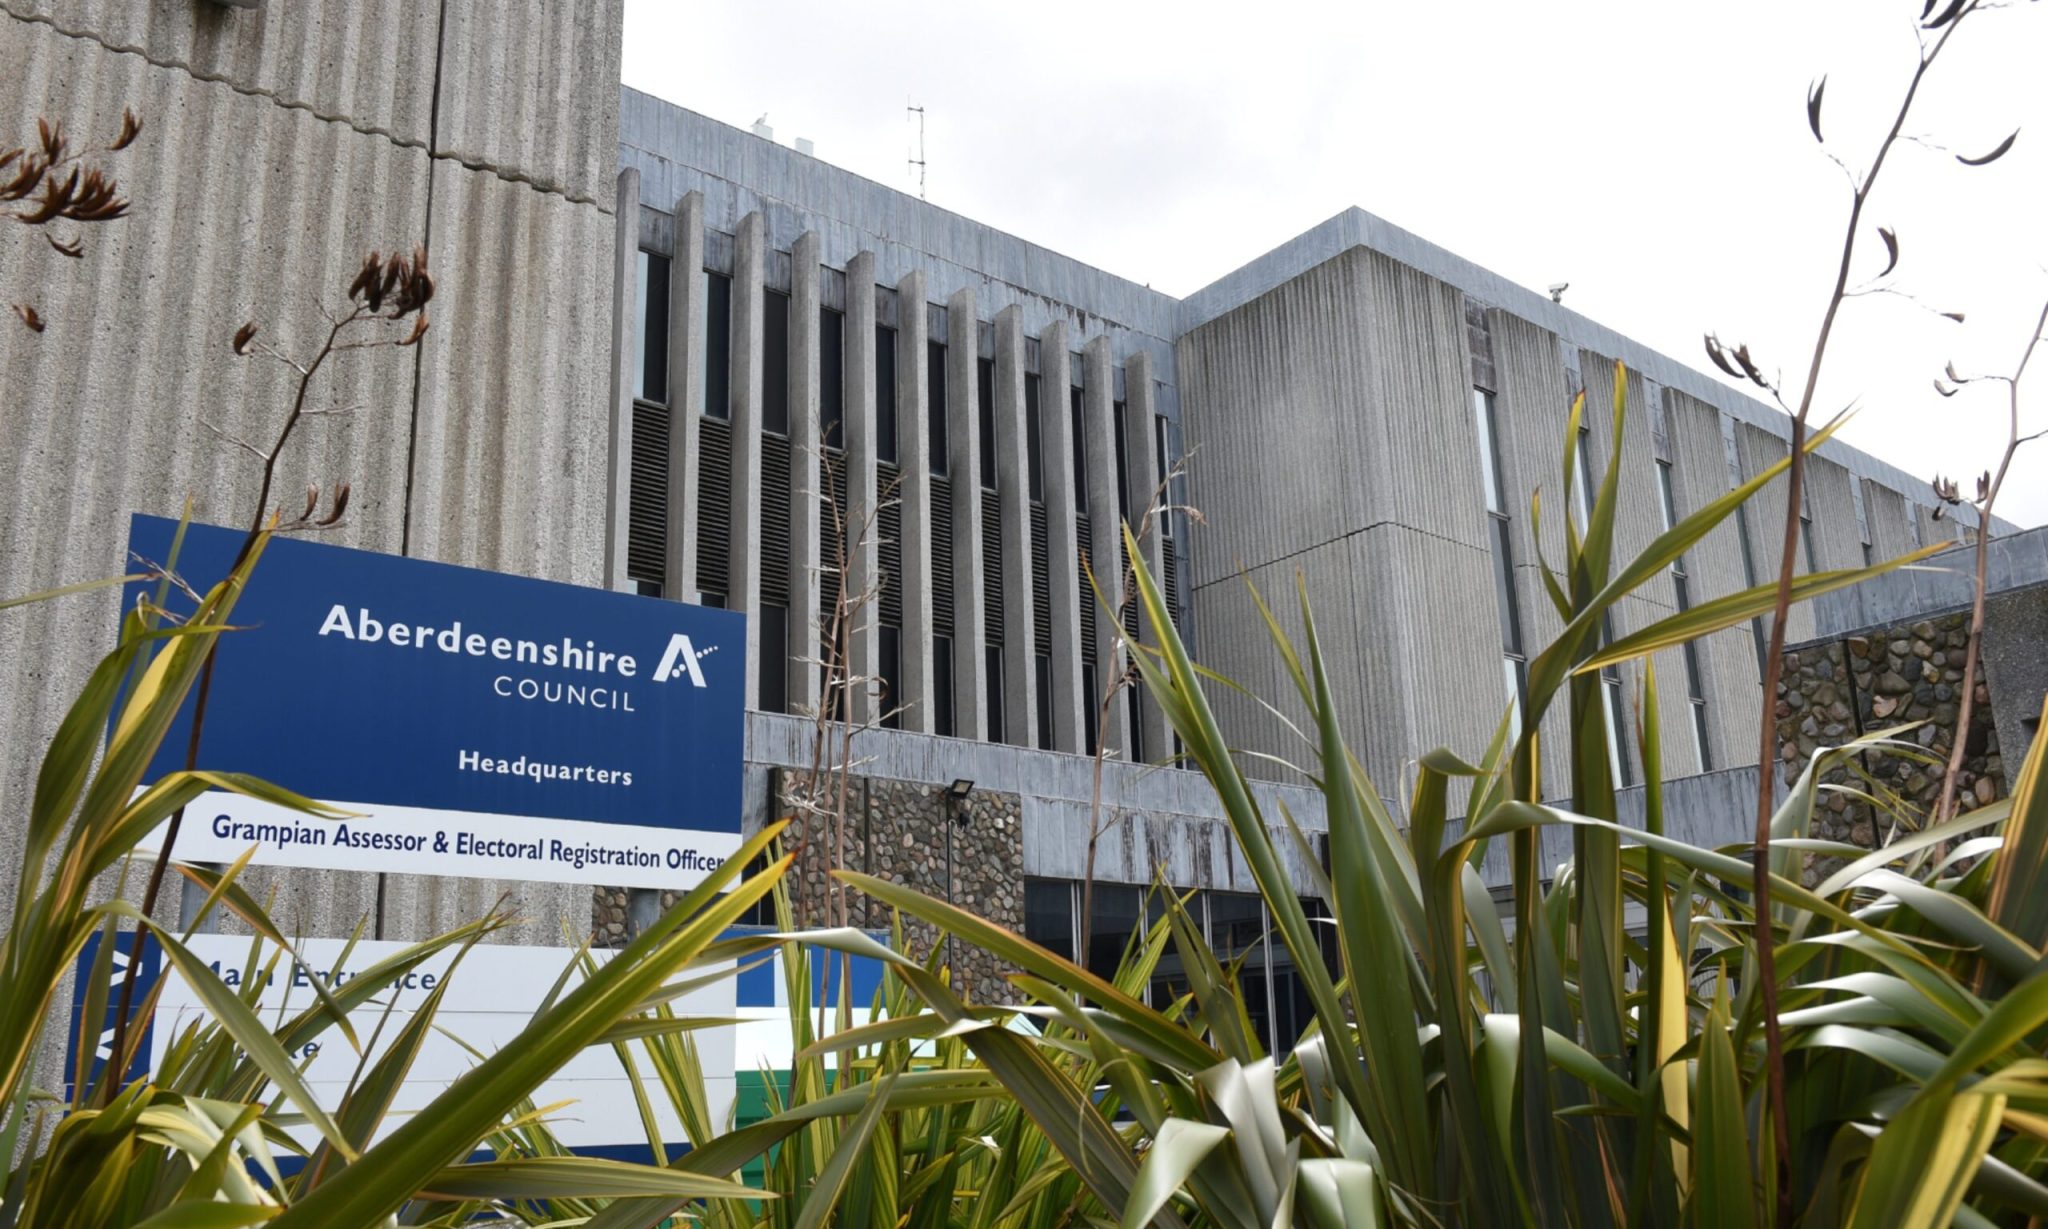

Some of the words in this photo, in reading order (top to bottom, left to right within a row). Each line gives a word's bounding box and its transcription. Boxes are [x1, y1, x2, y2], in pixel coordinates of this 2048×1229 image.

[318, 603, 638, 677] Aberdeenshire
[494, 676, 635, 712] COUNCIL
[459, 749, 633, 786] Headquarters
[212, 814, 325, 849] Grampian
[333, 824, 426, 852] Assessor
[433, 831, 449, 853] &
[456, 833, 543, 860] Electoral
[550, 840, 660, 869] Registration
[666, 848, 725, 872] Officer
